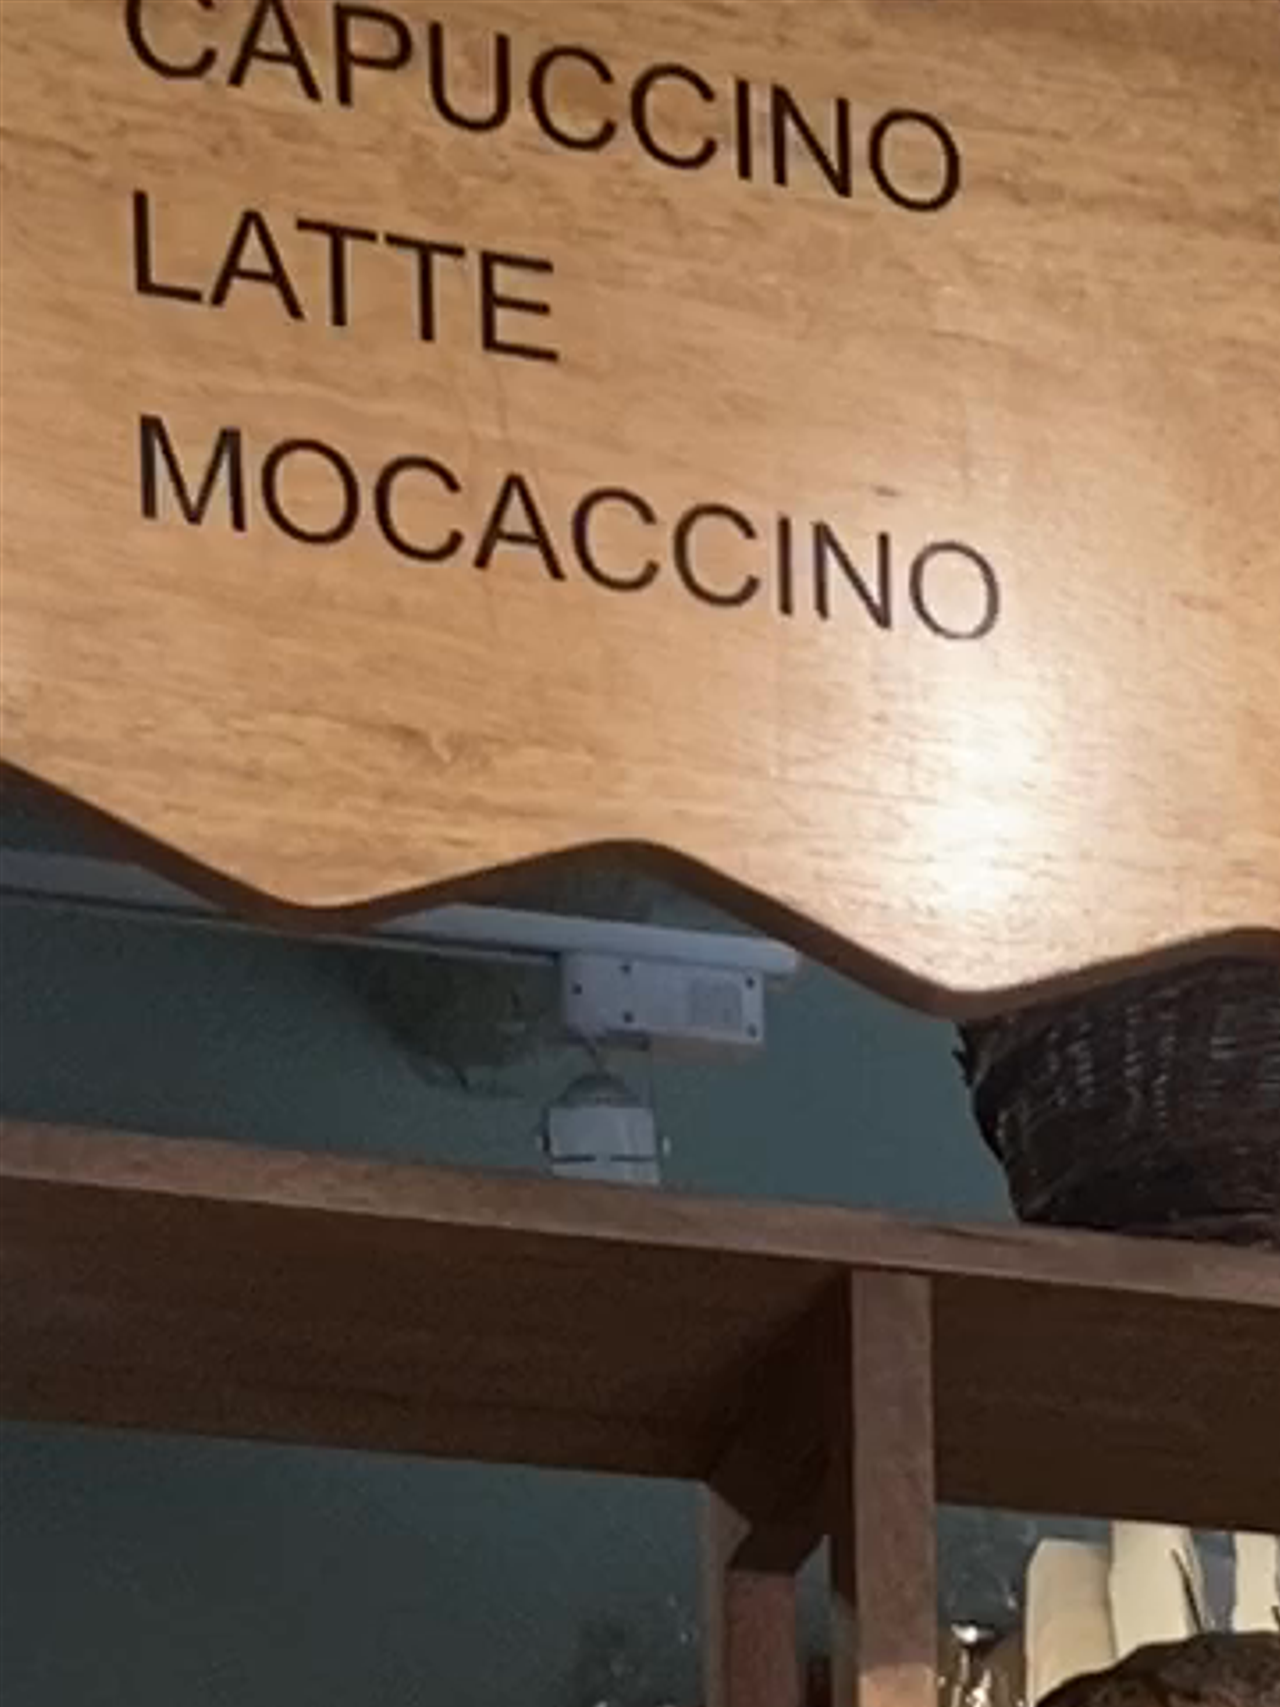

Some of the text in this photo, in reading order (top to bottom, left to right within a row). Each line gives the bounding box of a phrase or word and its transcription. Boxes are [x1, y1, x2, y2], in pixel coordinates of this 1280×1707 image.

[125, 0, 961, 213] CAPUCCINO
[131, 190, 560, 362] LATTE
[137, 415, 1000, 640] MOCACCINO
